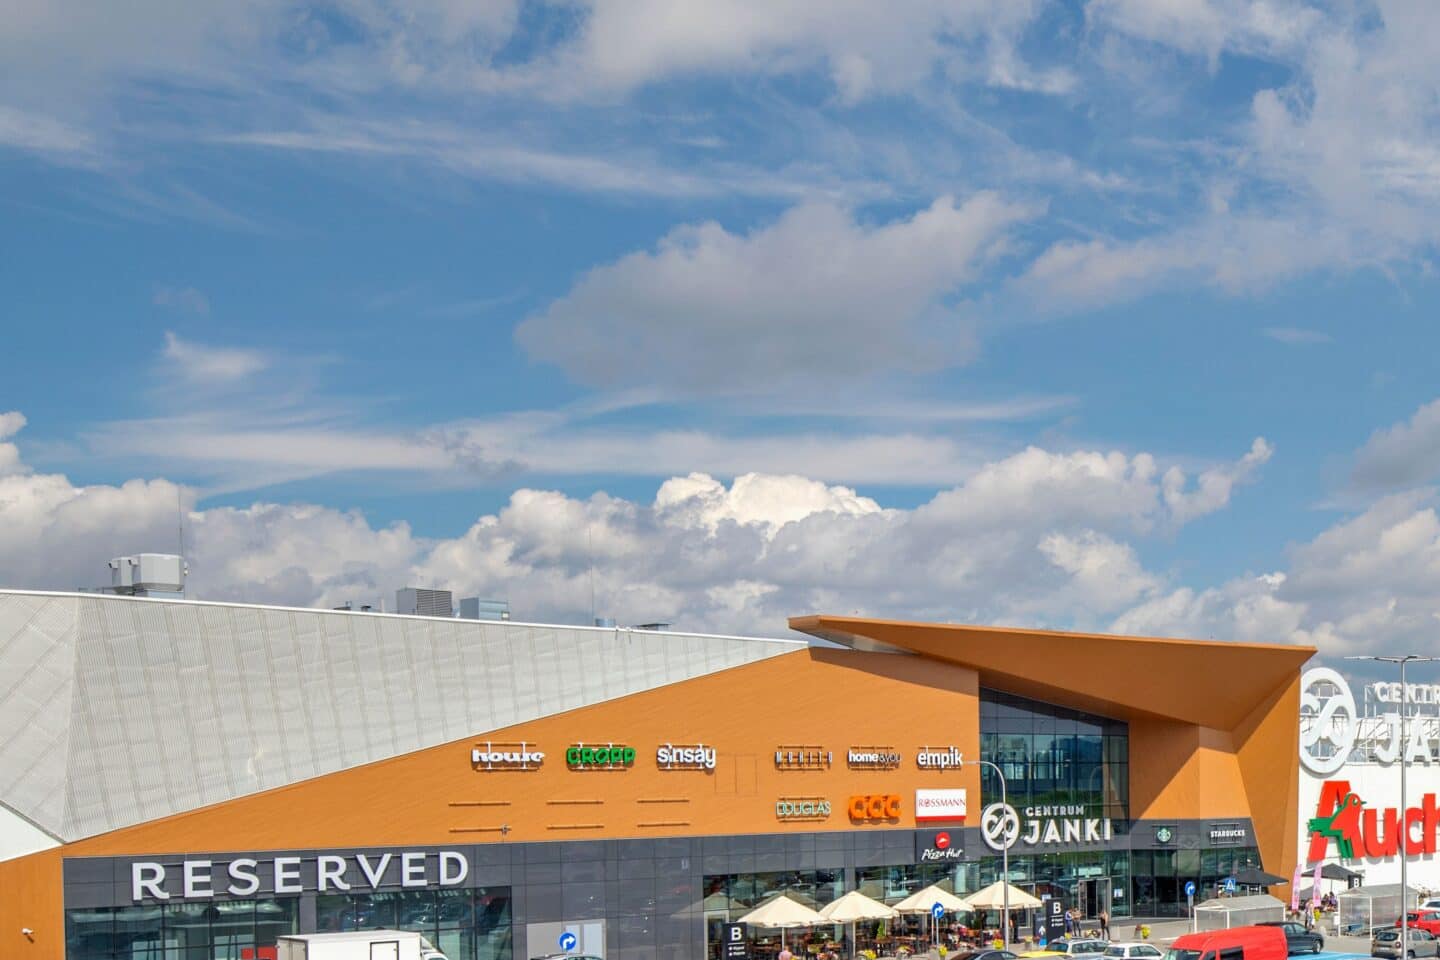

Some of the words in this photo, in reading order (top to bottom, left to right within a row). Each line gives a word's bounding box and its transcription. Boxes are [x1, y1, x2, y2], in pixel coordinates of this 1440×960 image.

[471, 749, 545, 763] house
[566, 747, 636, 765] CROPP
[656, 744, 716, 769] sinsay
[917, 746, 963, 769] empik
[776, 801, 832, 816] DOUGLAS
[848, 795, 902, 819] CCC
[918, 798, 966, 808] ROSSMANN
[1025, 805, 1085, 817] CENTRUM
[1023, 818, 1112, 845] JANKI
[1210, 829, 1245, 838] STARBUCKS
[921, 848, 946, 861] Pizza
[946, 848, 963, 859] Hut
[132, 851, 469, 901] RESERVED
[1053, 902, 1061, 914] B
[731, 927, 742, 941] B
